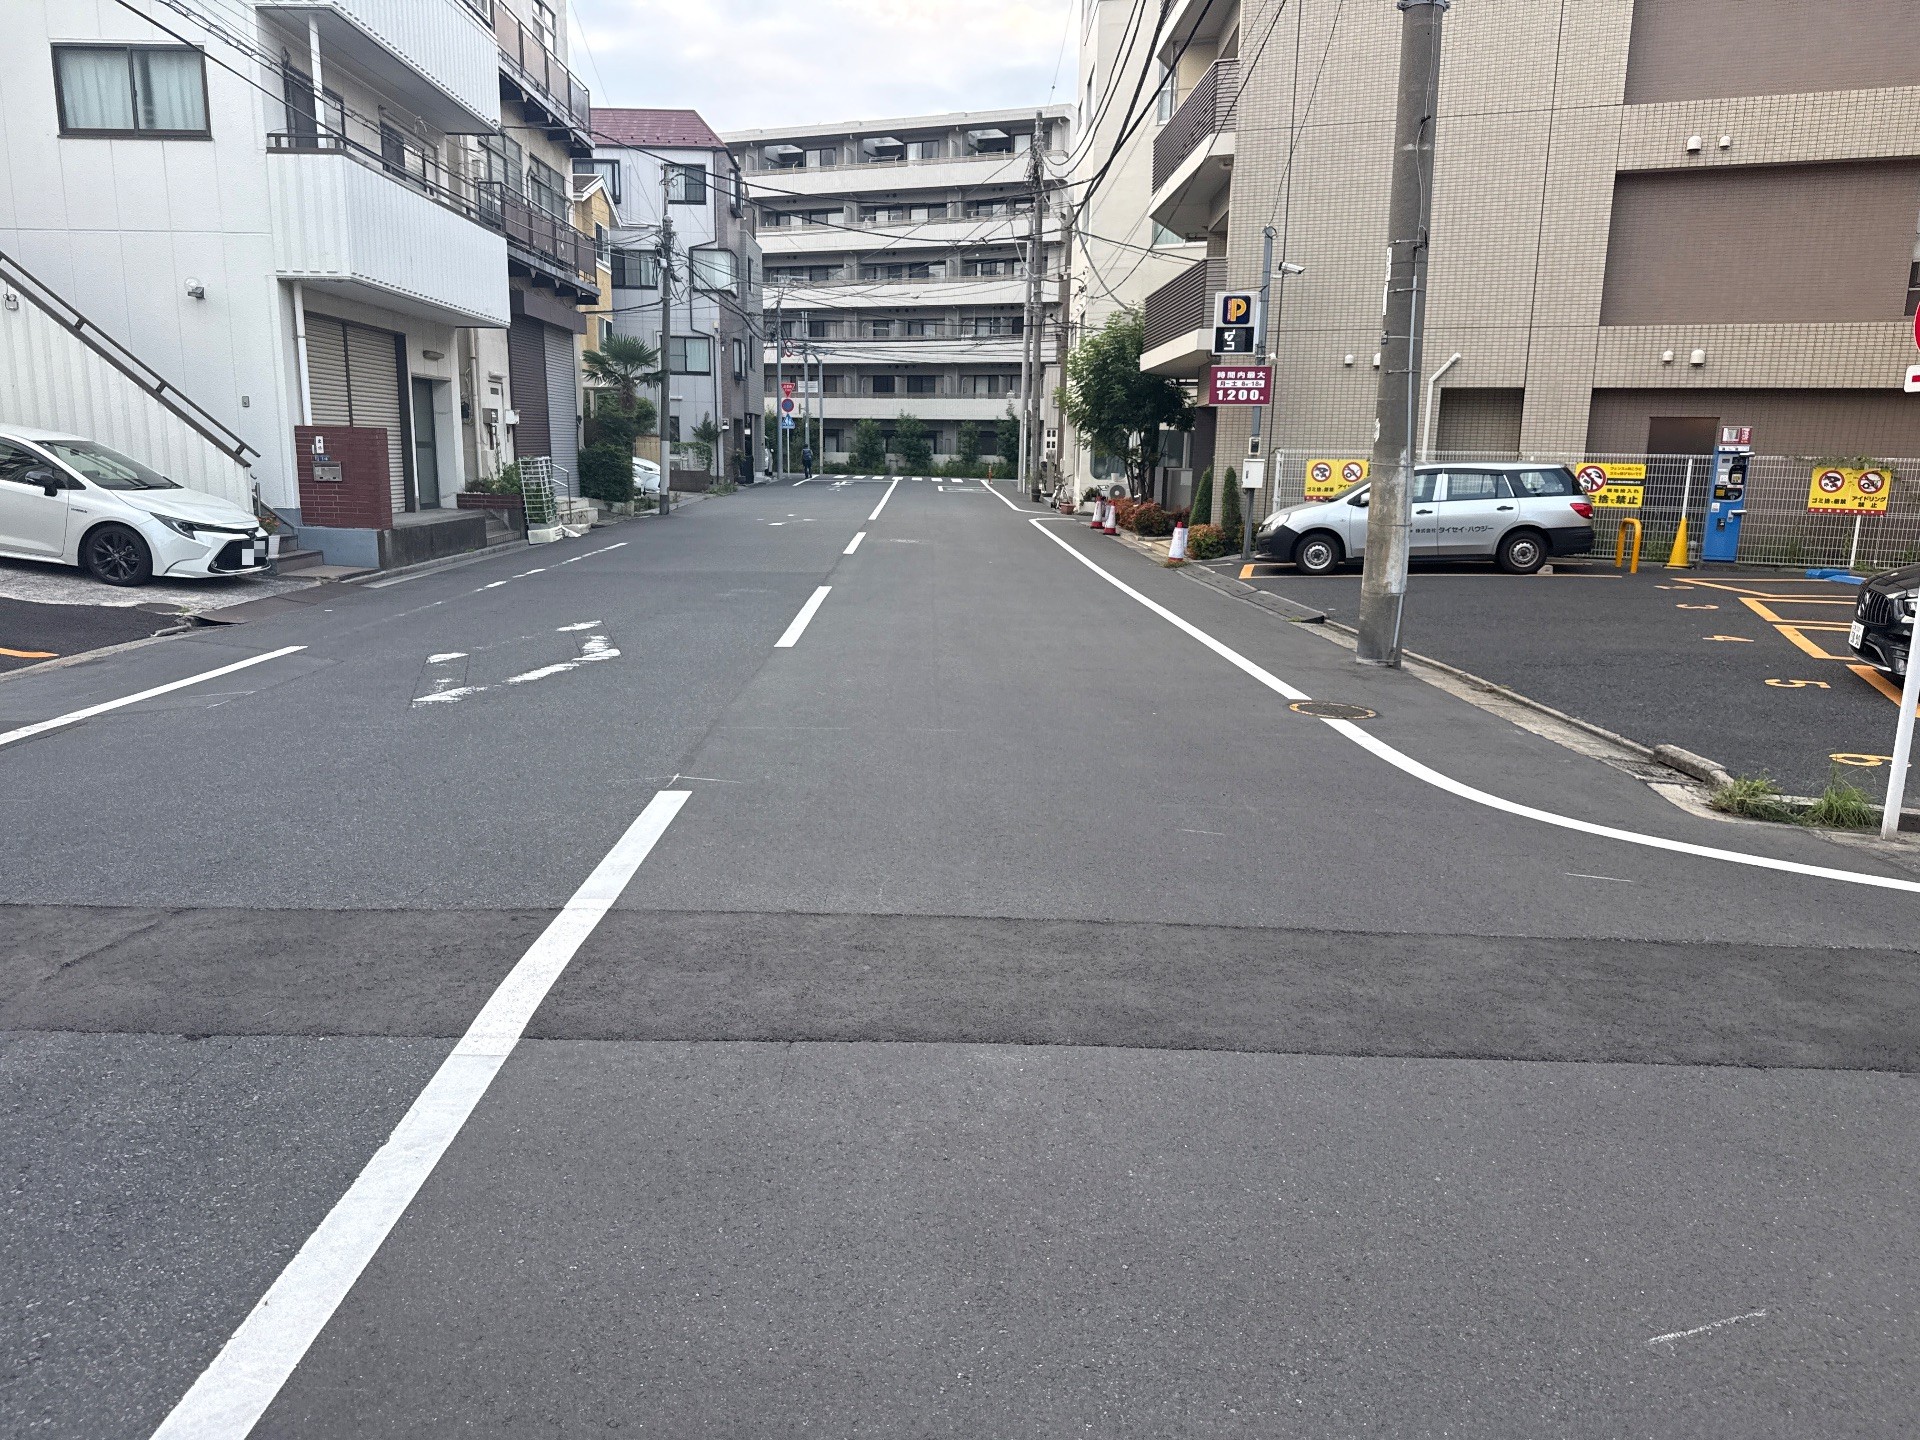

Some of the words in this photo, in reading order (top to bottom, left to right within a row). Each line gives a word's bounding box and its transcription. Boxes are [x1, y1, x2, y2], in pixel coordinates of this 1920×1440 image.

[1230, 298, 1247, 321] P
[1216, 371, 1266, 379] 時間内最大
[1589, 494, 1638, 505] ミ捨て禁止
